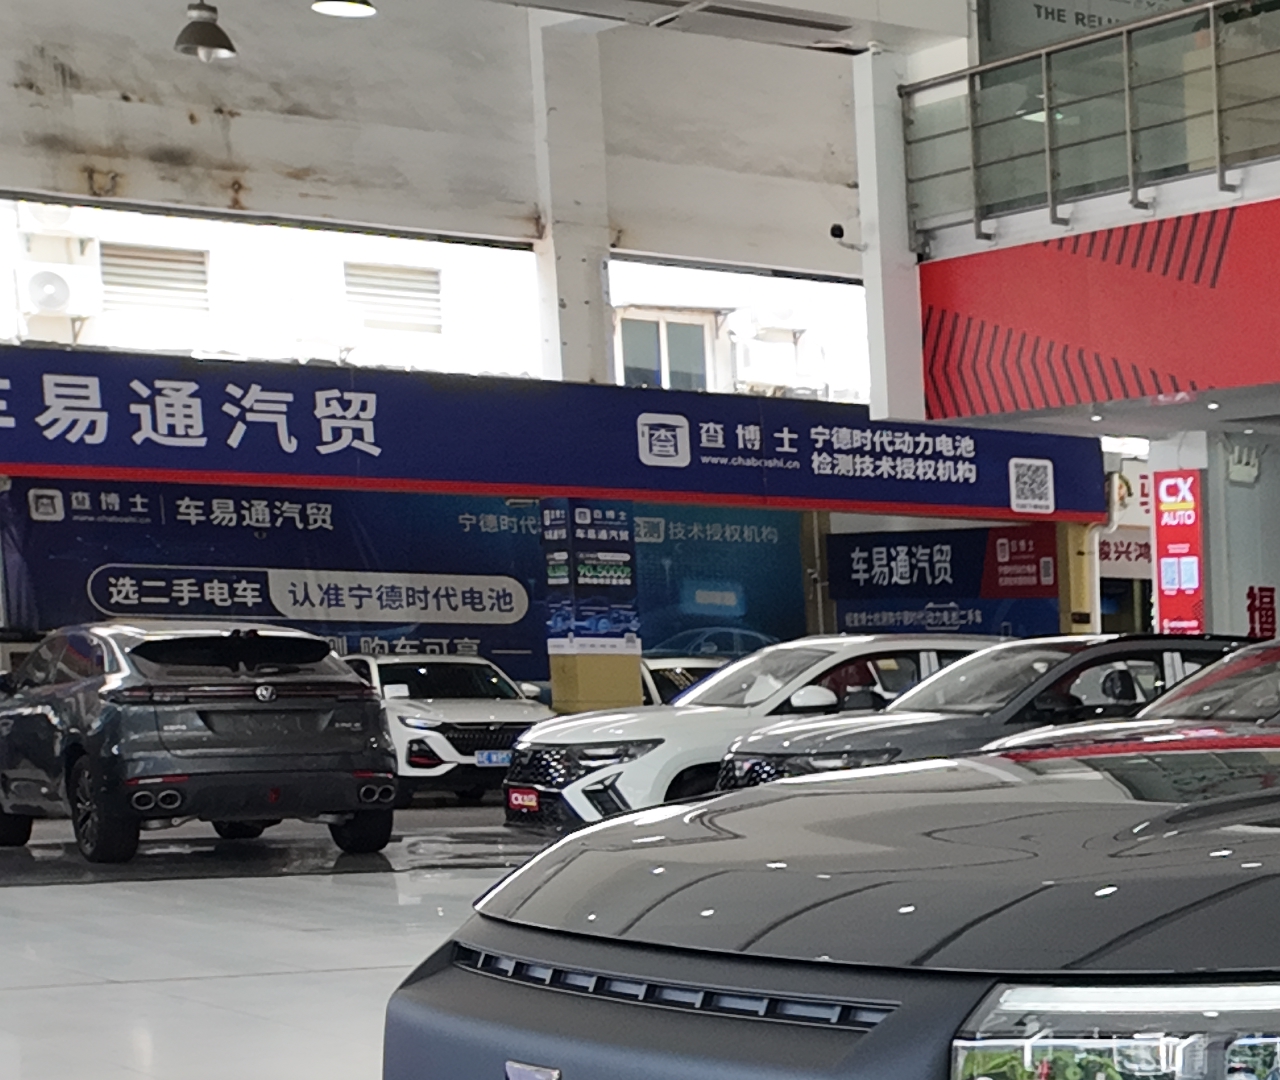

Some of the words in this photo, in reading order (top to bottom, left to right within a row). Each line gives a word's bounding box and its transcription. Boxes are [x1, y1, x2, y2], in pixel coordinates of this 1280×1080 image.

[1034, 4, 1066, 23] THE
[0, 374, 382, 457] 易通汽贸
[699, 422, 799, 453] 查博士
[810, 426, 976, 458] 宁德时代动力电池
[811, 451, 977, 484] 检测技术授权机构
[1159, 476, 1195, 504] CX
[176, 496, 333, 530] 车易通汽贸
[458, 512, 537, 535] 宁德时代
[668, 520, 779, 544] 技术授权机构
[1161, 509, 1196, 526] AUTO
[851, 544, 953, 586] 车易通汽贸
[108, 576, 263, 607] 选二手电车
[288, 581, 515, 613] 认准宁德时代电池
